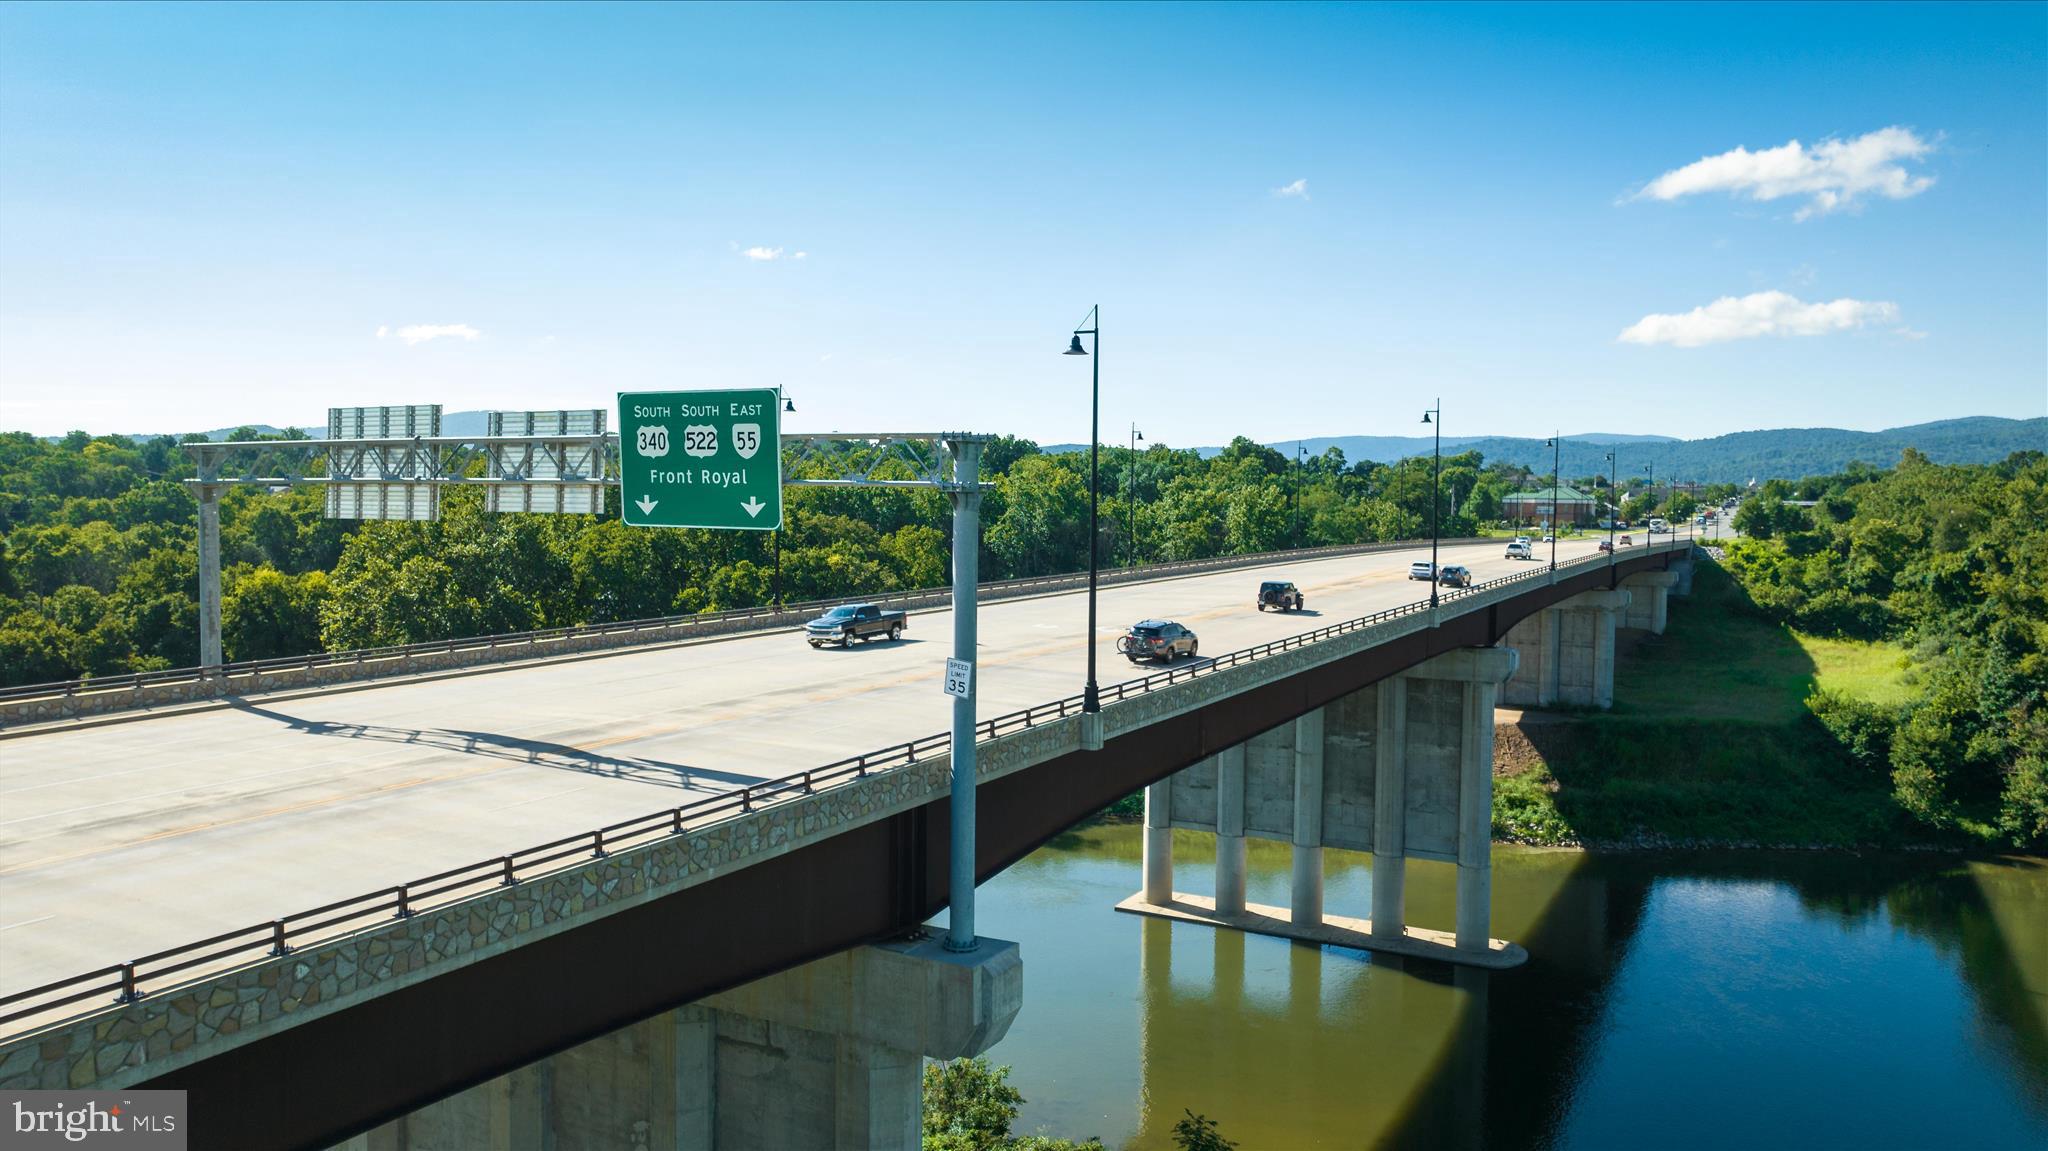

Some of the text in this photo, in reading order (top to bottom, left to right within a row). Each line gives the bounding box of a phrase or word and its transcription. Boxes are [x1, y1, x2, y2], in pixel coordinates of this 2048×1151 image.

[634, 403, 762, 418] SOUTH SOUTH EAST
[640, 431, 757, 450] 340 522 55
[650, 468, 747, 488] Front Royal
[949, 662, 969, 671] SPEED
[948, 679, 966, 694] 35
